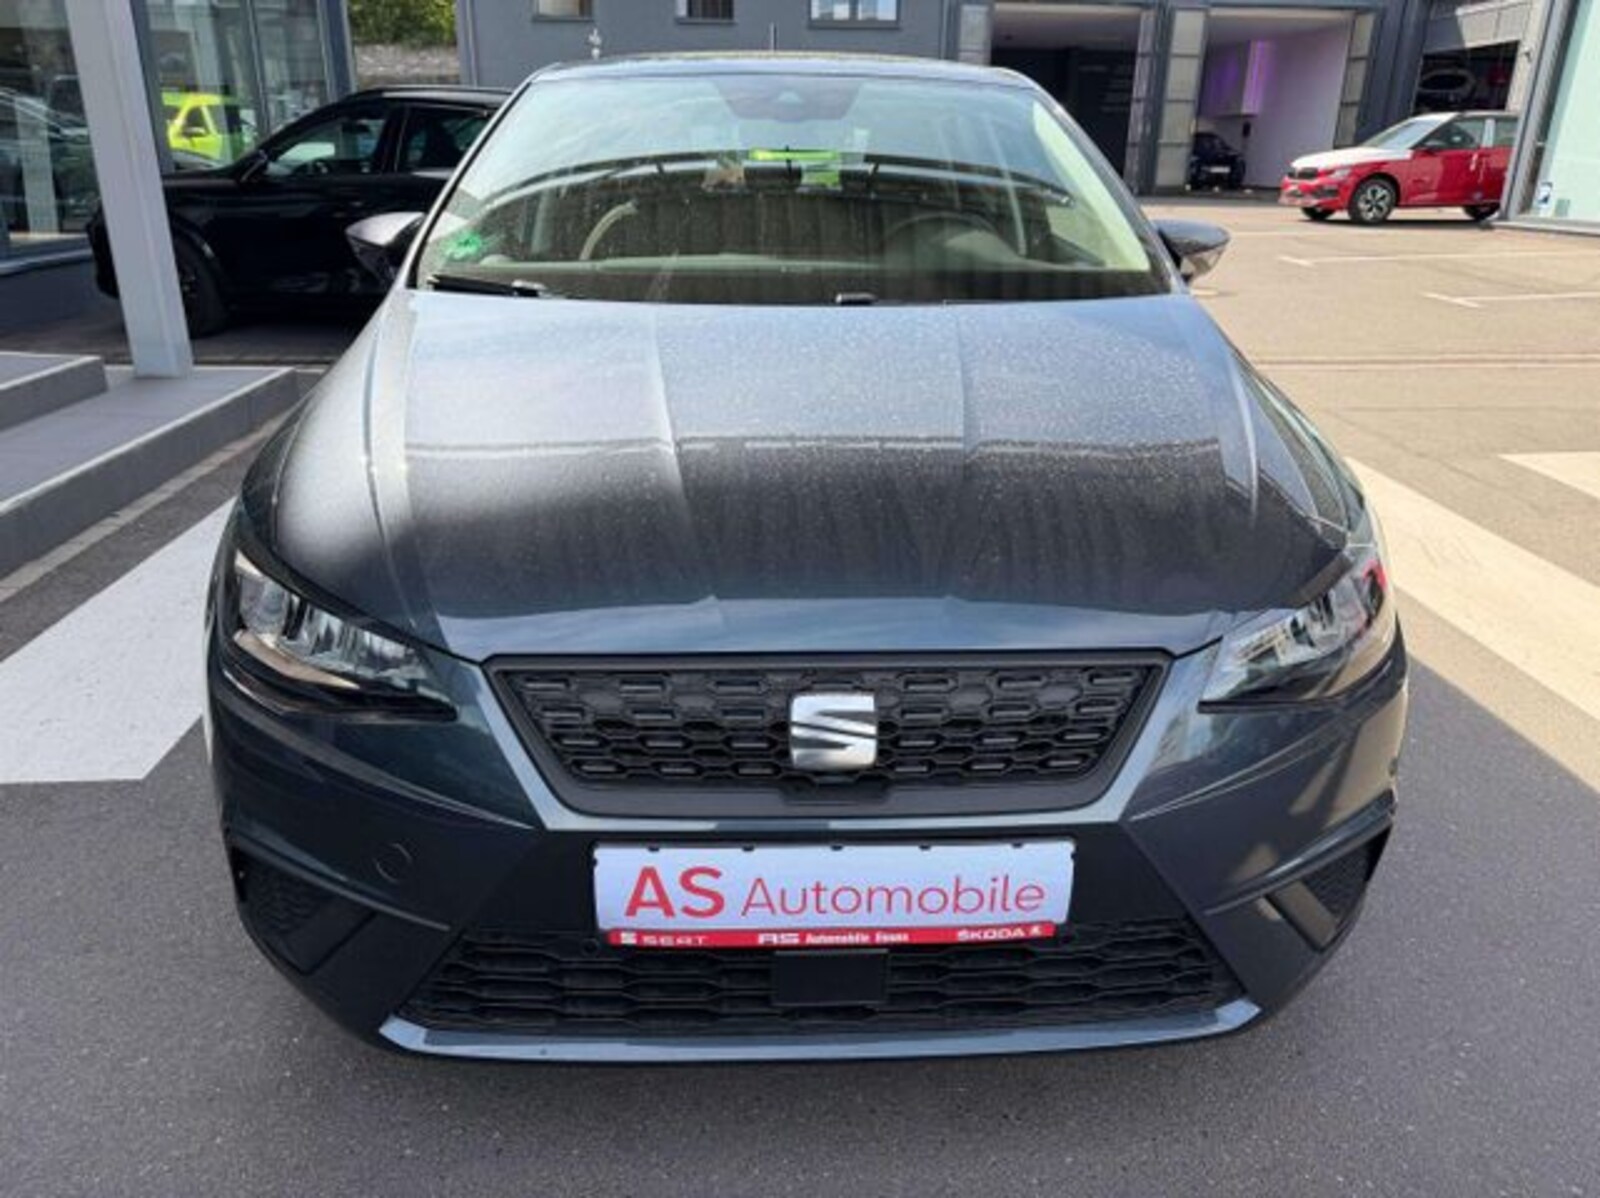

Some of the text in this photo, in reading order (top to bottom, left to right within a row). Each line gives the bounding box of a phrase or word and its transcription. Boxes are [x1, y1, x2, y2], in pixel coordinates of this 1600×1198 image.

[625, 866, 1044, 918] AS Automobile
[642, 934, 706, 946] SEAT
